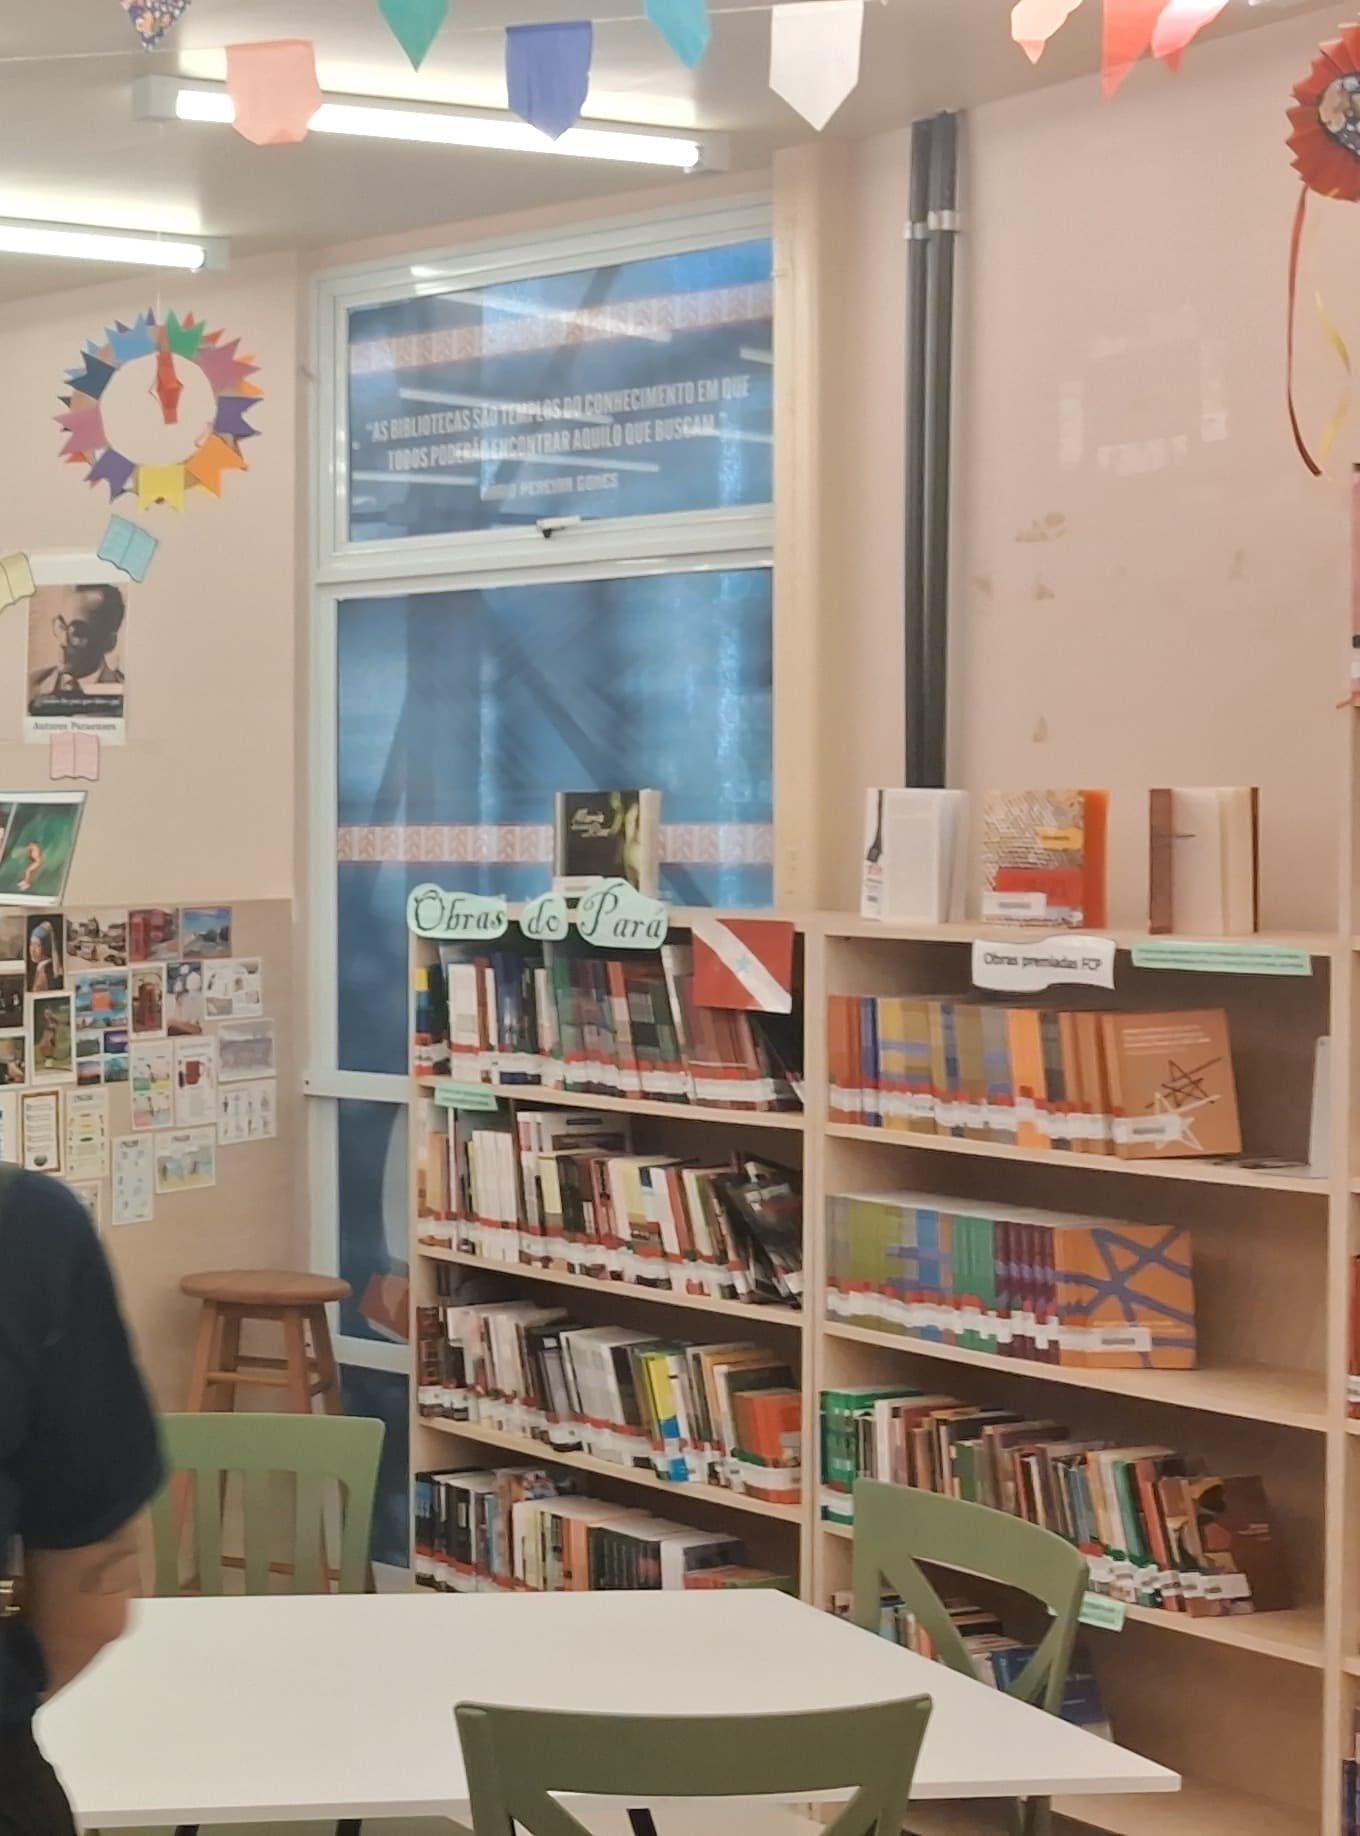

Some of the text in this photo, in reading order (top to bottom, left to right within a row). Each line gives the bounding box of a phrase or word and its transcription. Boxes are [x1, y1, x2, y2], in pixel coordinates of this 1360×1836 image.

[390, 409, 471, 441] BIBLIOTECAS
[563, 394, 582, 419] DO
[585, 380, 694, 416] CONHECIMENTO
[697, 377, 719, 403] EM
[722, 374, 751, 402] QUE
[387, 446, 428, 472] TODOS
[572, 423, 622, 452] AQUILO
[625, 421, 651, 447] QUE
[413, 882, 664, 938] Obras do Pará
[983, 952, 1103, 971] Obras premiadas FCP
